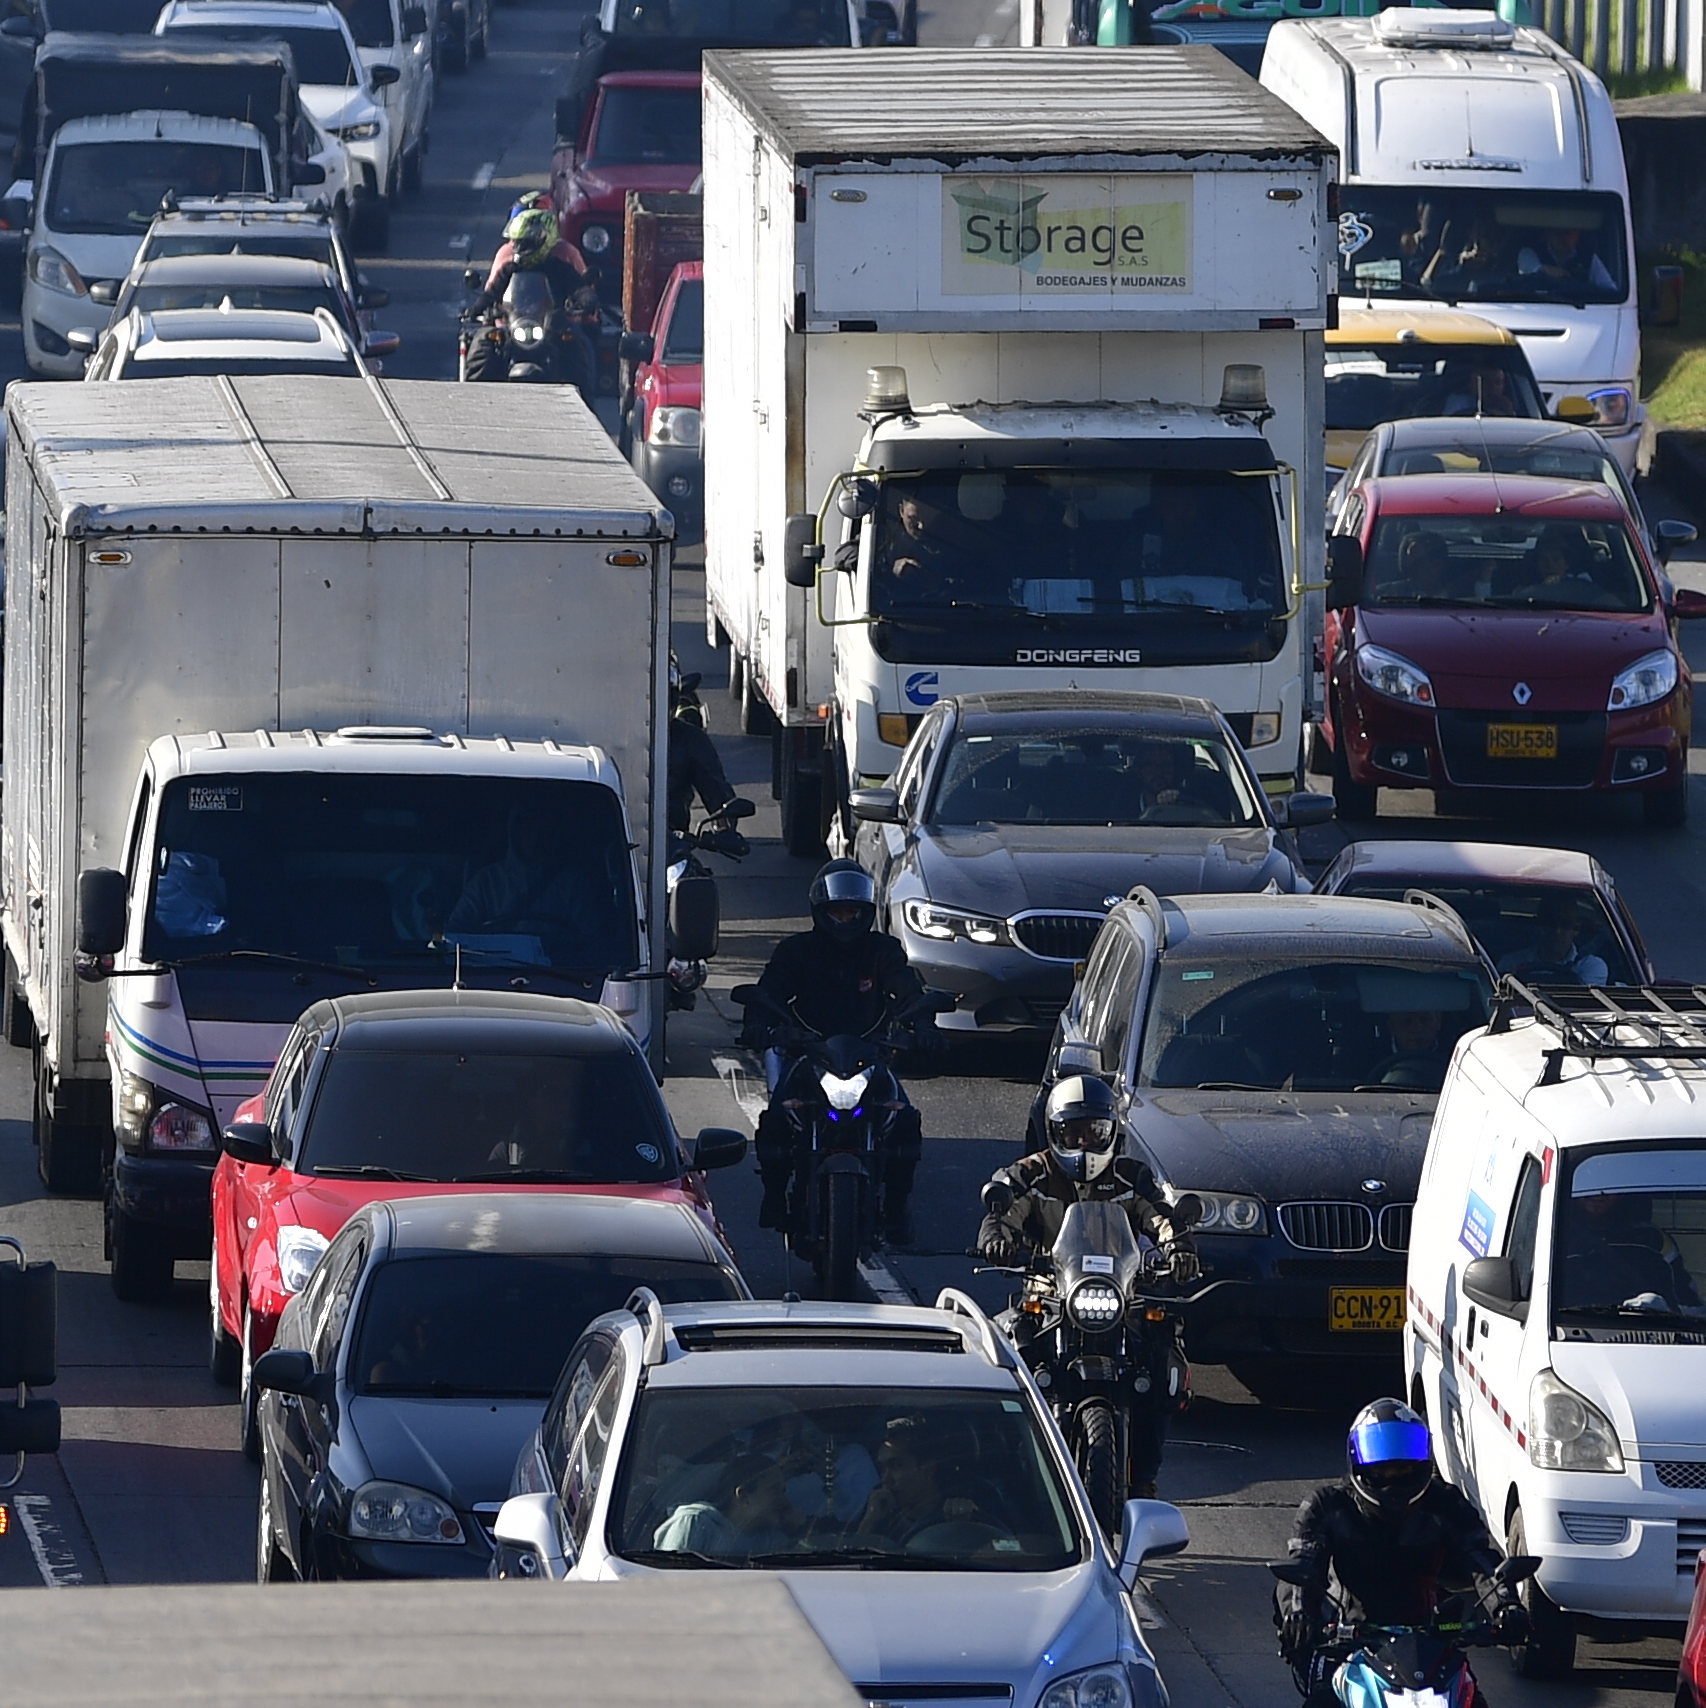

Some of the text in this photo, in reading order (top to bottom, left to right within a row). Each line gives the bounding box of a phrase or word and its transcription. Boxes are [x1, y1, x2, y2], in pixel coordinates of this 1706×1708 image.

[966, 214, 1145, 266] Storage
[1118, 255, 1149, 267] S.A.S
[1036, 276, 1108, 287] BODEGAJES
[1121, 277, 1186, 287] MUDANZAS
[1016, 649, 1141, 663] DONGFENG
[190, 787, 240, 796] PROHIBIDO
[190, 794, 227, 802] LLEVAR
[190, 801, 228, 810] PASAJEROS
